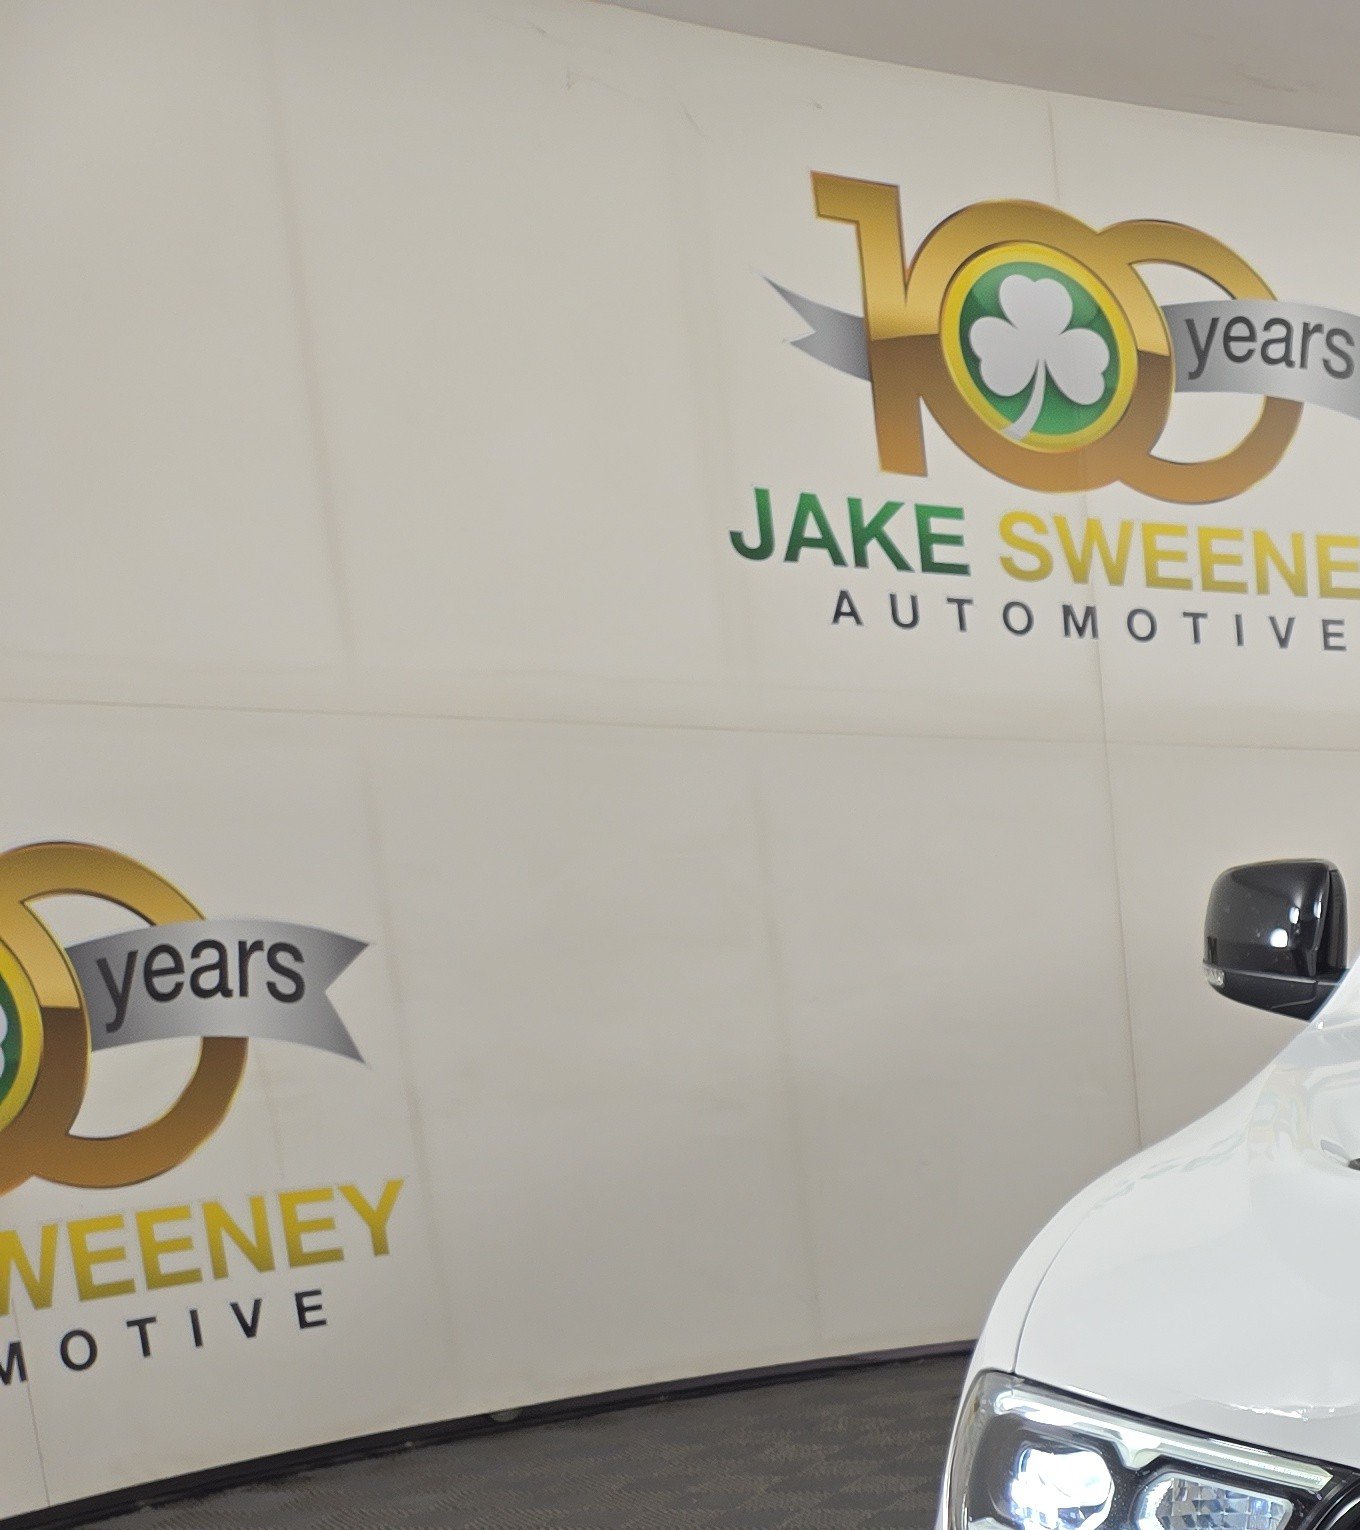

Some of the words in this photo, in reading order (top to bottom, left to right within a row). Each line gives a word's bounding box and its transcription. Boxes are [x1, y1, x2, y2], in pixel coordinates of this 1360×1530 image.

[1186, 313, 1356, 380] years
[730, 487, 971, 576] JAKE
[832, 589, 1347, 652] AUTOMOTIVE
[97, 939, 305, 1033] years
